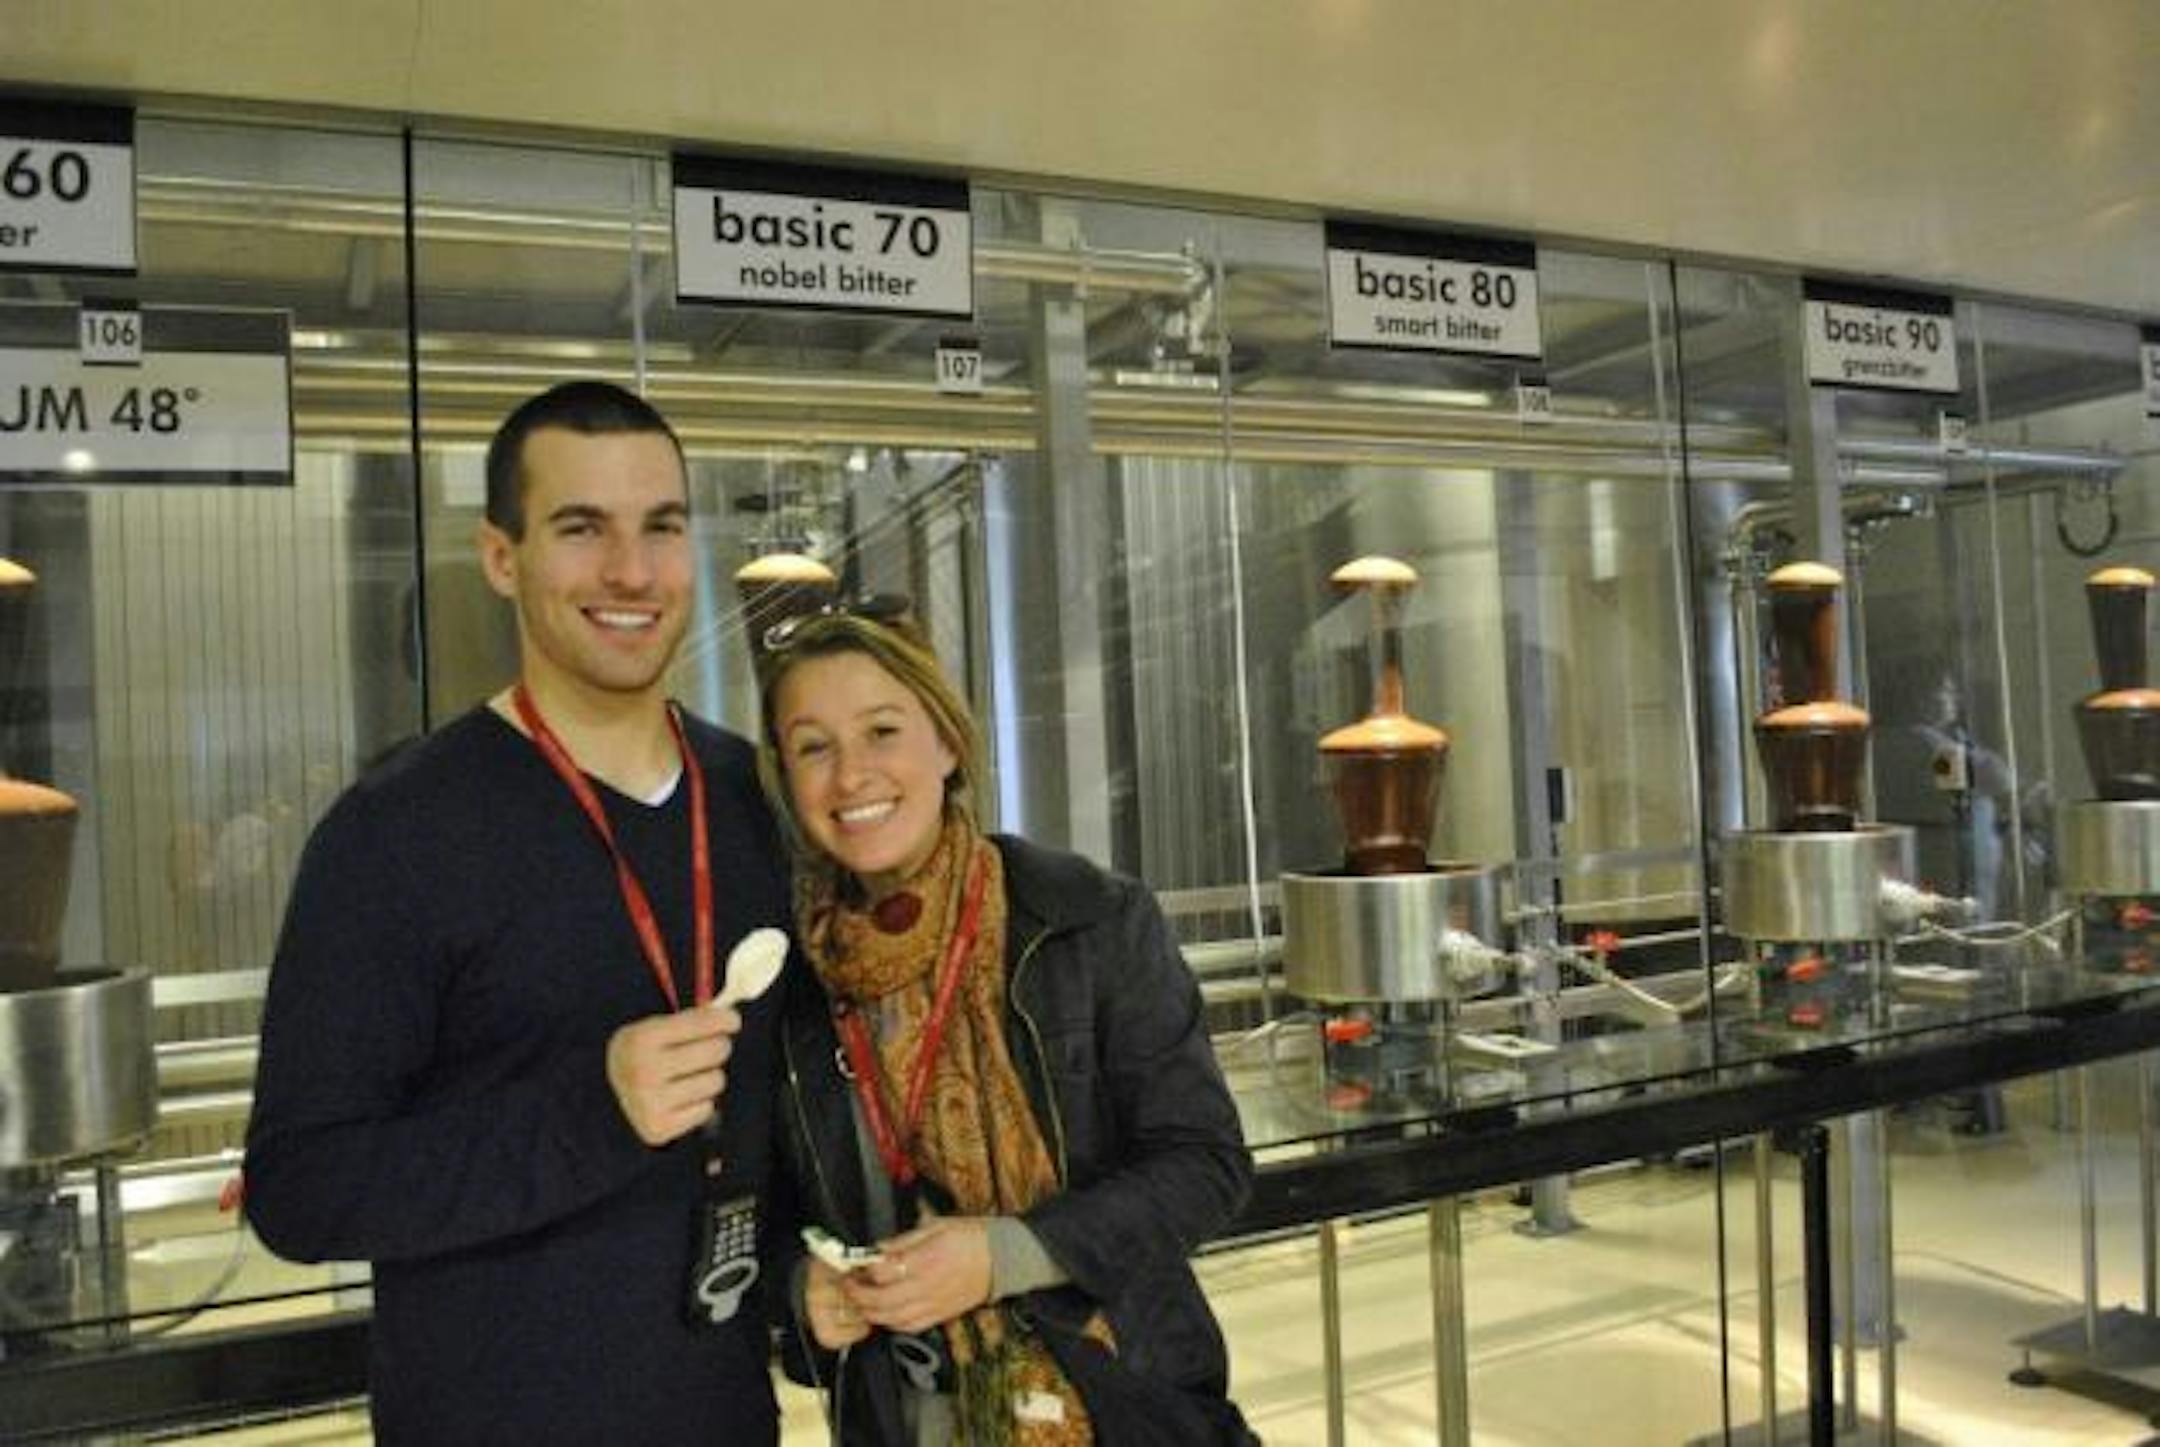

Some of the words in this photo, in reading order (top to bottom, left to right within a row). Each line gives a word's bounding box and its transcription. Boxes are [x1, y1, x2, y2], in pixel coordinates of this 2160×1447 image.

[3, 148, 90, 203] 60
[713, 195, 855, 251] basic
[874, 211, 940, 258] 70
[740, 261, 827, 290] nobel
[839, 266, 917, 296] bitter
[1355, 256, 1457, 304] basic
[1471, 270, 1516, 309] 80
[86, 318, 137, 346] 106
[1374, 313, 1438, 337] smart
[1446, 316, 1502, 342] bitter
[1824, 305, 1896, 346] basic
[1908, 318, 1940, 353] 90
[943, 355, 978, 379] 107
